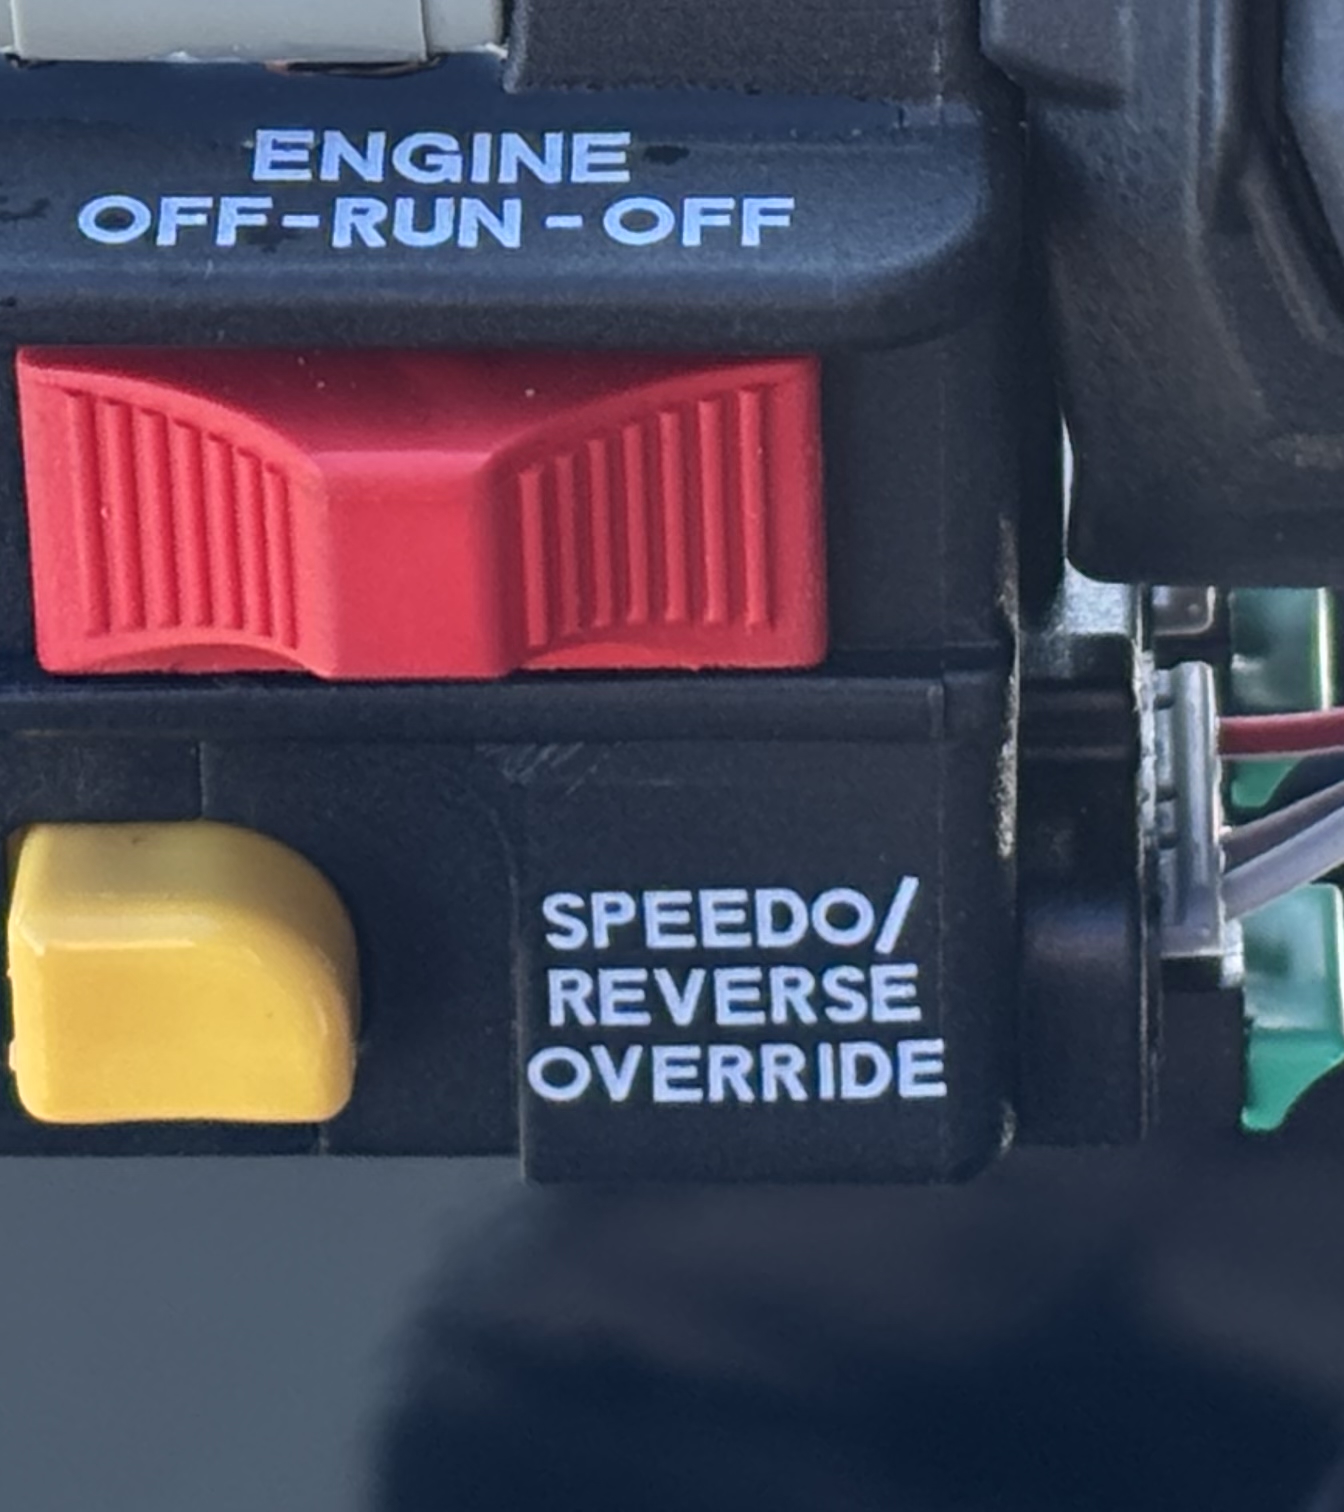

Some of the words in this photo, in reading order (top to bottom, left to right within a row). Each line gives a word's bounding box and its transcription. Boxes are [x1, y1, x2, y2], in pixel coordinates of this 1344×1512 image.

[252, 129, 631, 184] ENGINE
[542, 875, 920, 955] SPEEDO/
[547, 963, 922, 1026] REVERSE
[527, 1038, 948, 1103] OVERRIDE
